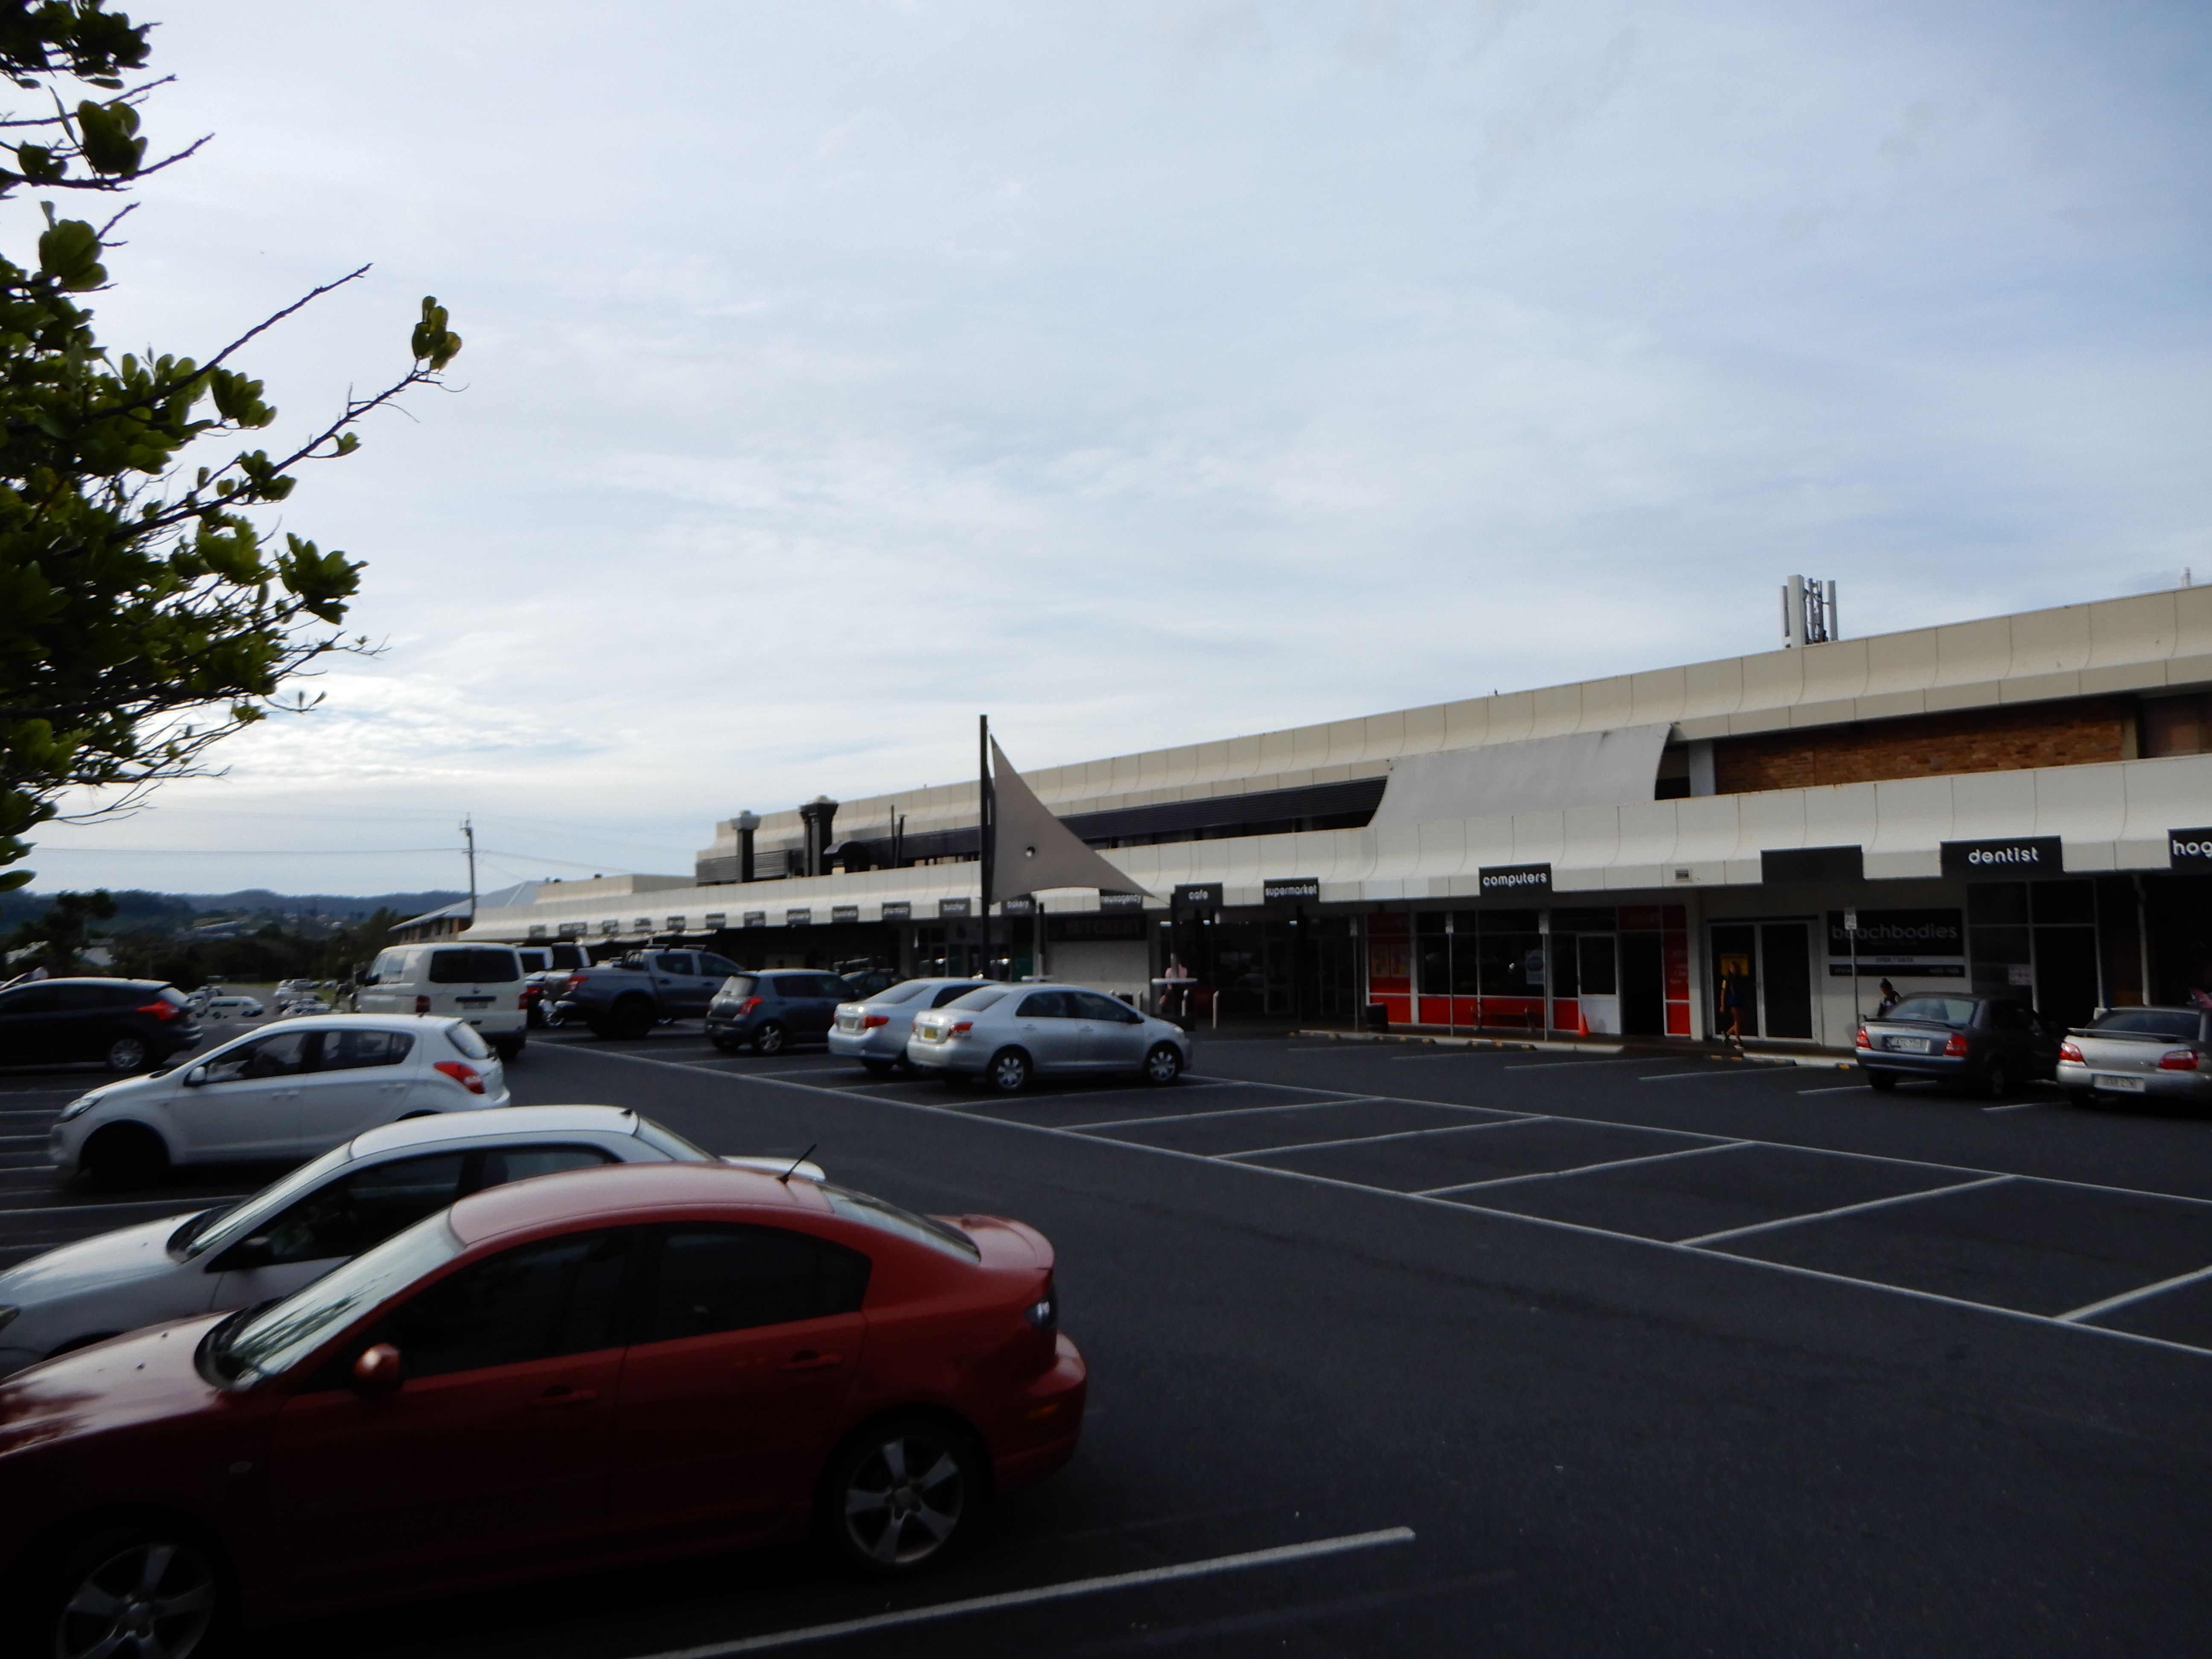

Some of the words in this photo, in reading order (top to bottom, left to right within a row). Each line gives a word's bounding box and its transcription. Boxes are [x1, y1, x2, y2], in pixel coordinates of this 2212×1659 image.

[1968, 847, 2039, 864] dentist
[1482, 872, 1547, 887] computers
[1188, 889, 1208, 900] cafe
[1264, 884, 1317, 897] supermarket
